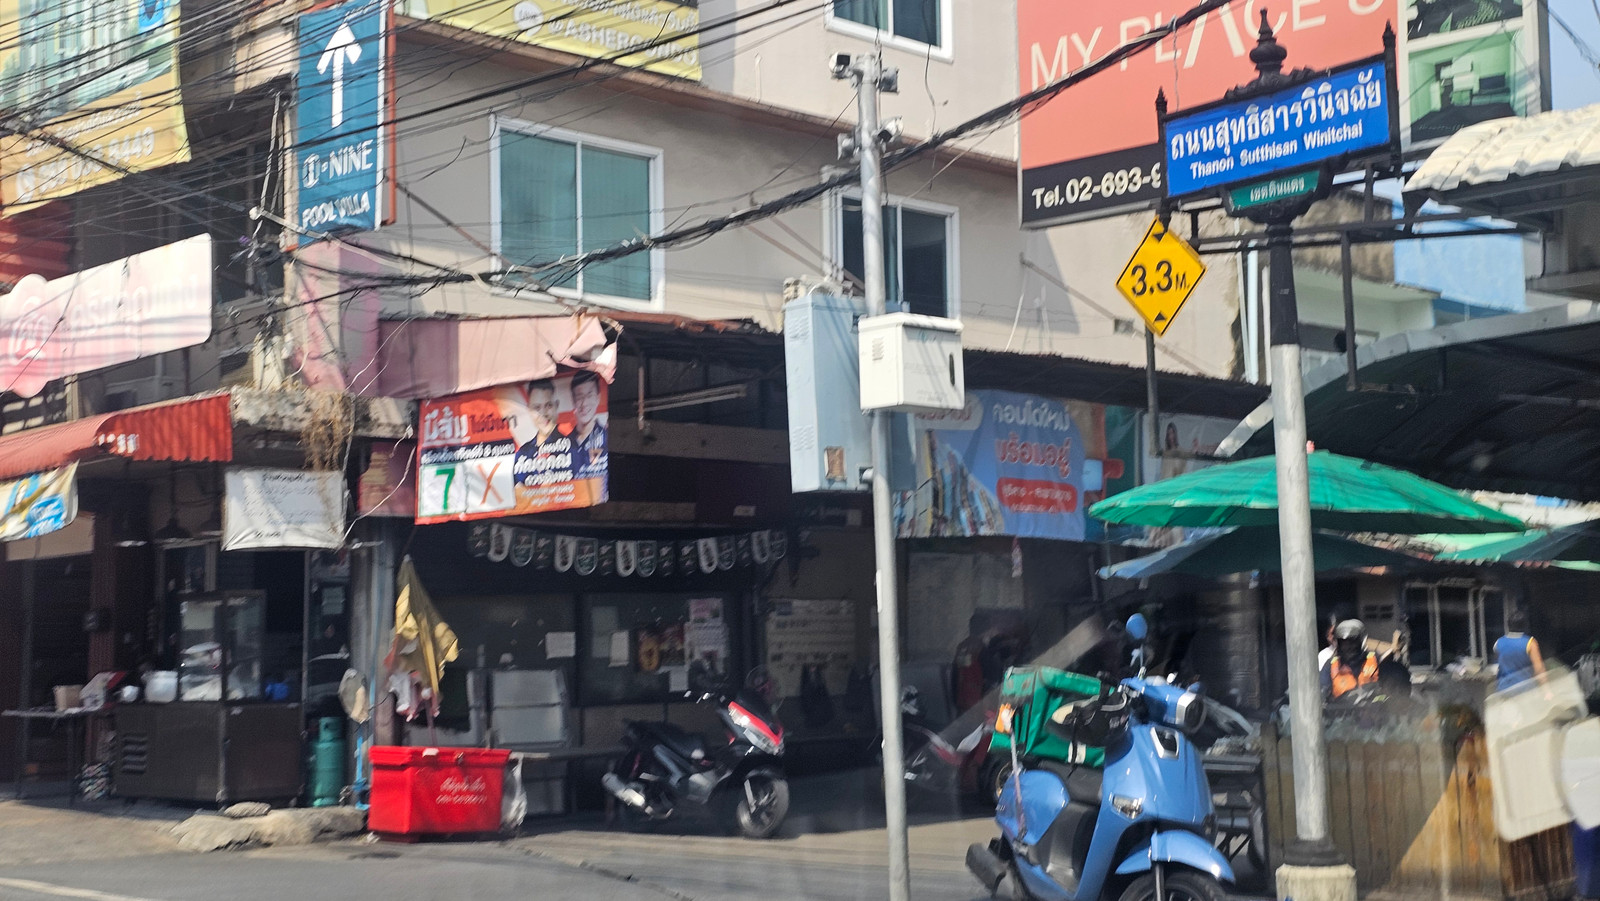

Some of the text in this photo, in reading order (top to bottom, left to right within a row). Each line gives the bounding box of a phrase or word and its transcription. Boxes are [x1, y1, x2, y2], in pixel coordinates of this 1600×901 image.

[1030, 26, 1103, 95] MY
[1171, 69, 1382, 161] ถนนสุทธิสารวินิจฉัย
[1190, 119, 1364, 180] Thanon Sutthisan Winitchai
[302, 190, 371, 230] POOL VILLA
[1249, 177, 1305, 203] เขตดินแดง
[994, 431, 1072, 479] พร้อมอยู่
[434, 465, 456, 511] 7
